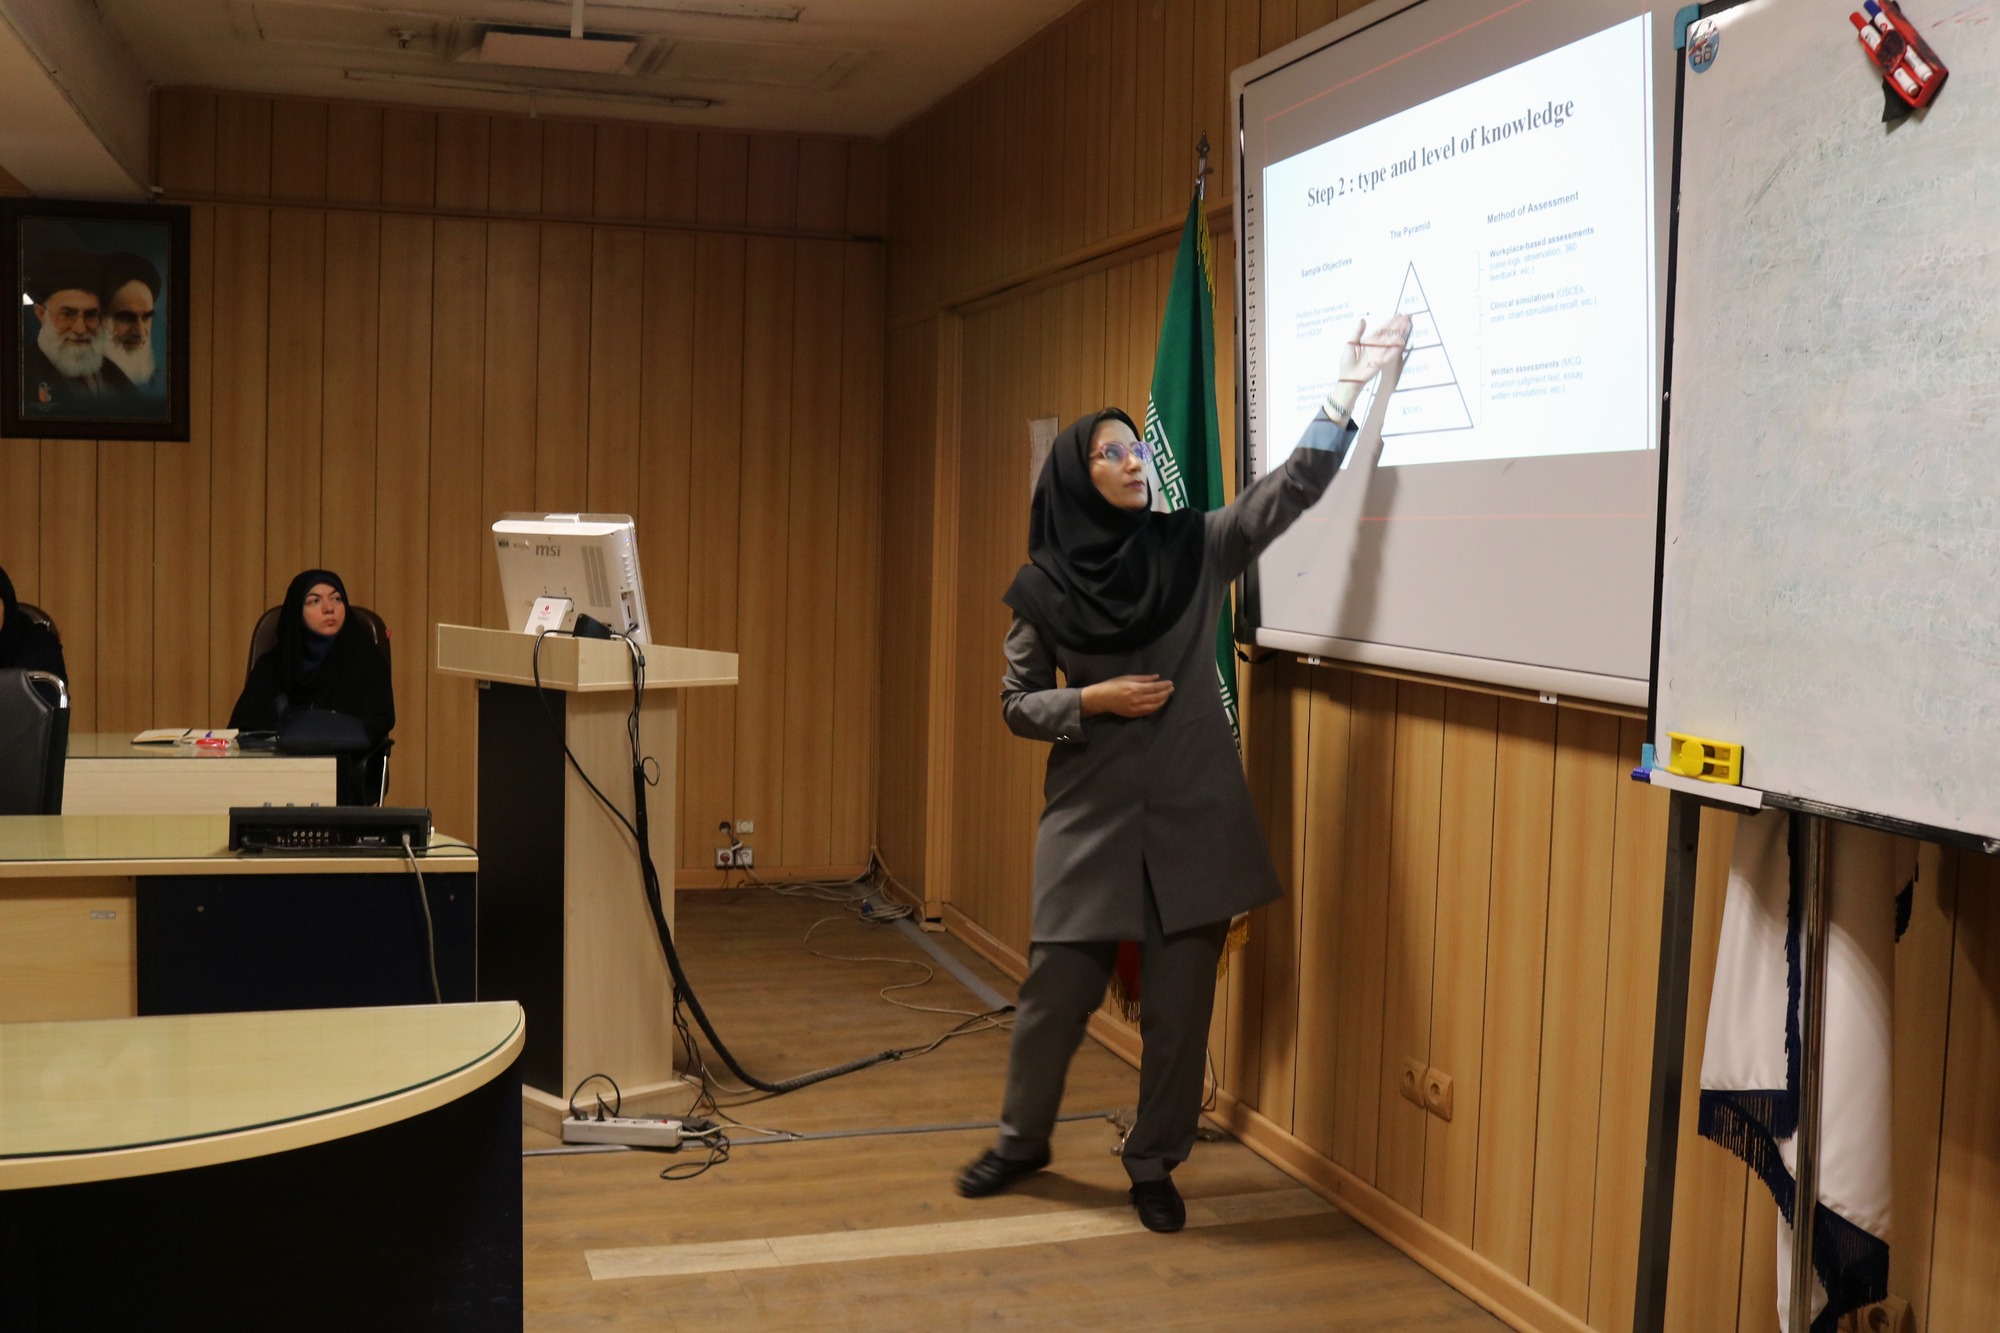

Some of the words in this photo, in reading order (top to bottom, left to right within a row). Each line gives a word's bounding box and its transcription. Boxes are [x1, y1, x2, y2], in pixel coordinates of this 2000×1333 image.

[1307, 185, 1335, 207] Step
[1338, 176, 1345, 196] 2
[1358, 166, 1387, 193] type
[1391, 150, 1417, 178] and
[1421, 136, 1456, 168] level
[1460, 128, 1477, 154] of
[1481, 99, 1574, 146] knowledge
[1487, 208, 1516, 224] Method
[1517, 204, 1526, 216] of
[1527, 191, 1579, 214] Assessment
[1390, 230, 1402, 240] The
[1403, 220, 1431, 238] Pyramid
[1489, 238, 1546, 258] Workplace-based
[1547, 227, 1595, 244] assessments
[1300, 265, 1321, 278] Sample
[1322, 257, 1353, 273] Objectives
[1490, 299, 1515, 311] Clinical
[1515, 291, 1555, 306] simulations
[1490, 366, 1514, 376] Written
[1515, 360, 1560, 373] assessments
[535, 544, 561, 557] msi
